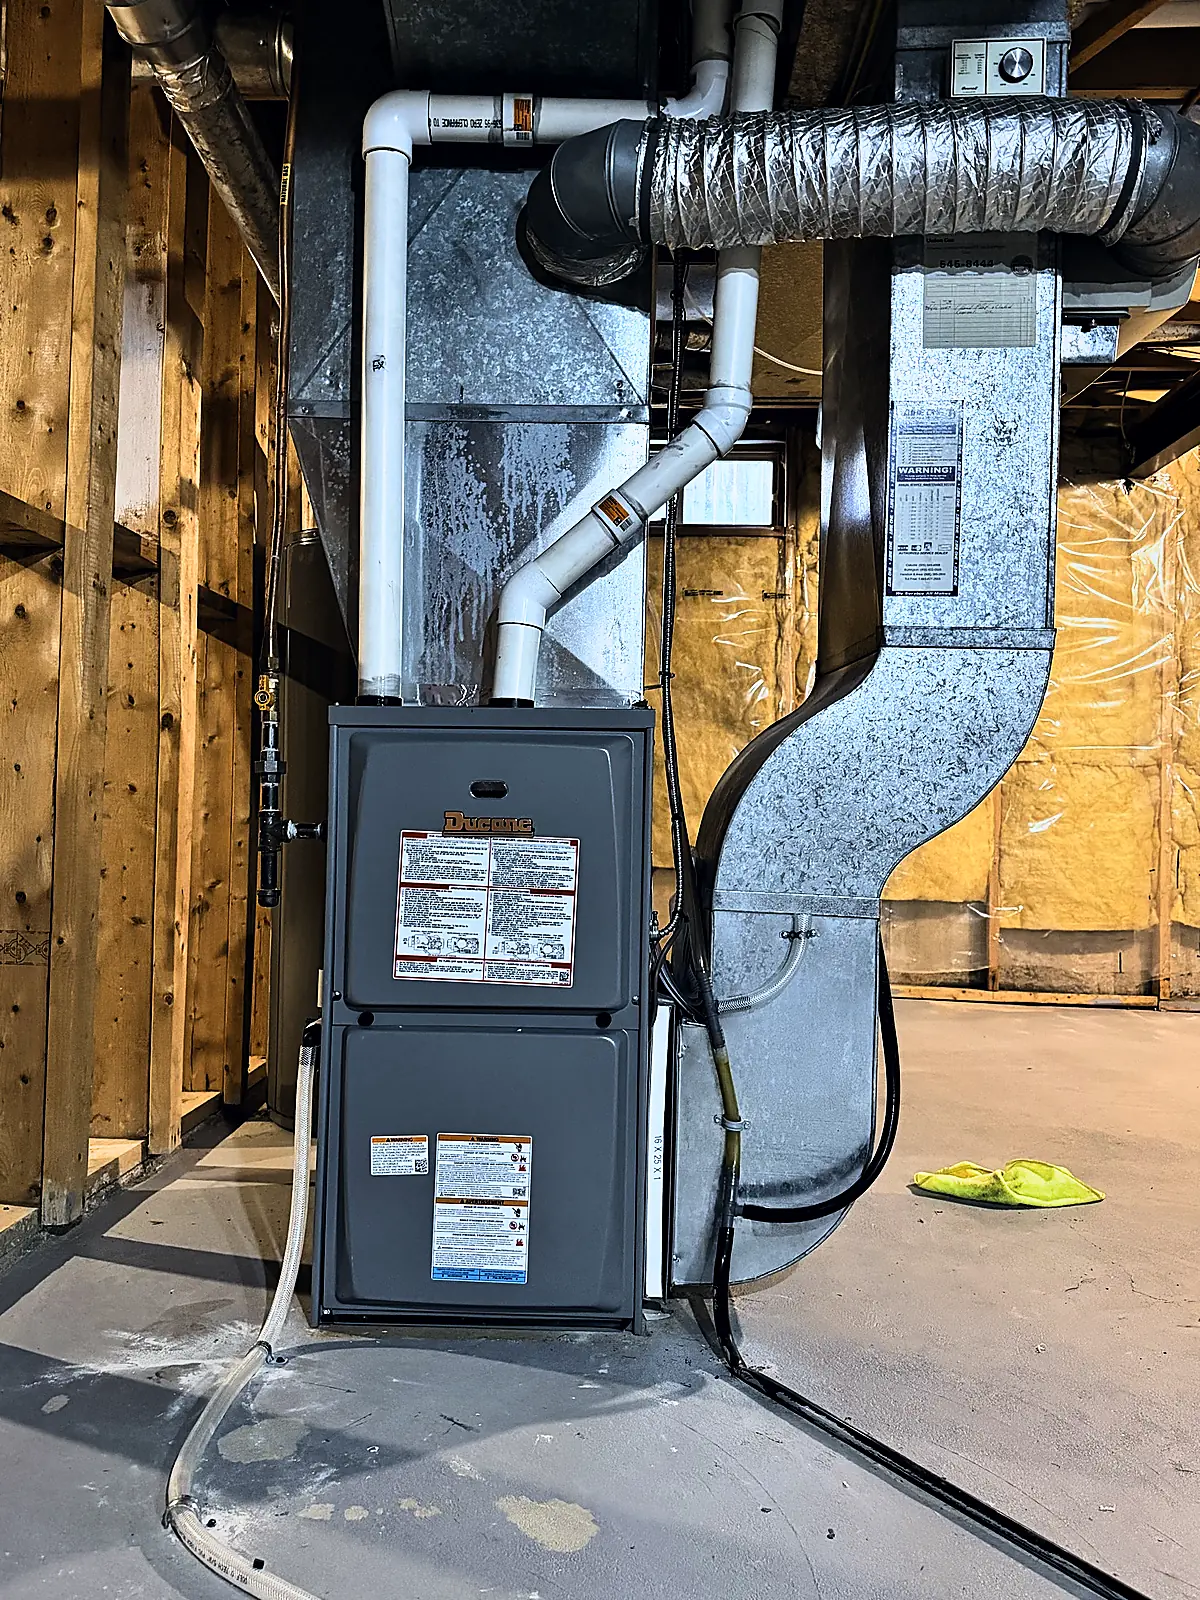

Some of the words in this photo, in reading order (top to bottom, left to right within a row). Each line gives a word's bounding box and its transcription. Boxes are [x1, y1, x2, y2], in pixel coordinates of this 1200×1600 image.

[442, 118, 468, 128] CLEARANCE
[471, 119, 482, 128] ZERO
[898, 466, 953, 474] WARNING!
[444, 810, 533, 833] Ducane
[654, 1135, 662, 1144] 16
[653, 1154, 662, 1164] 25
